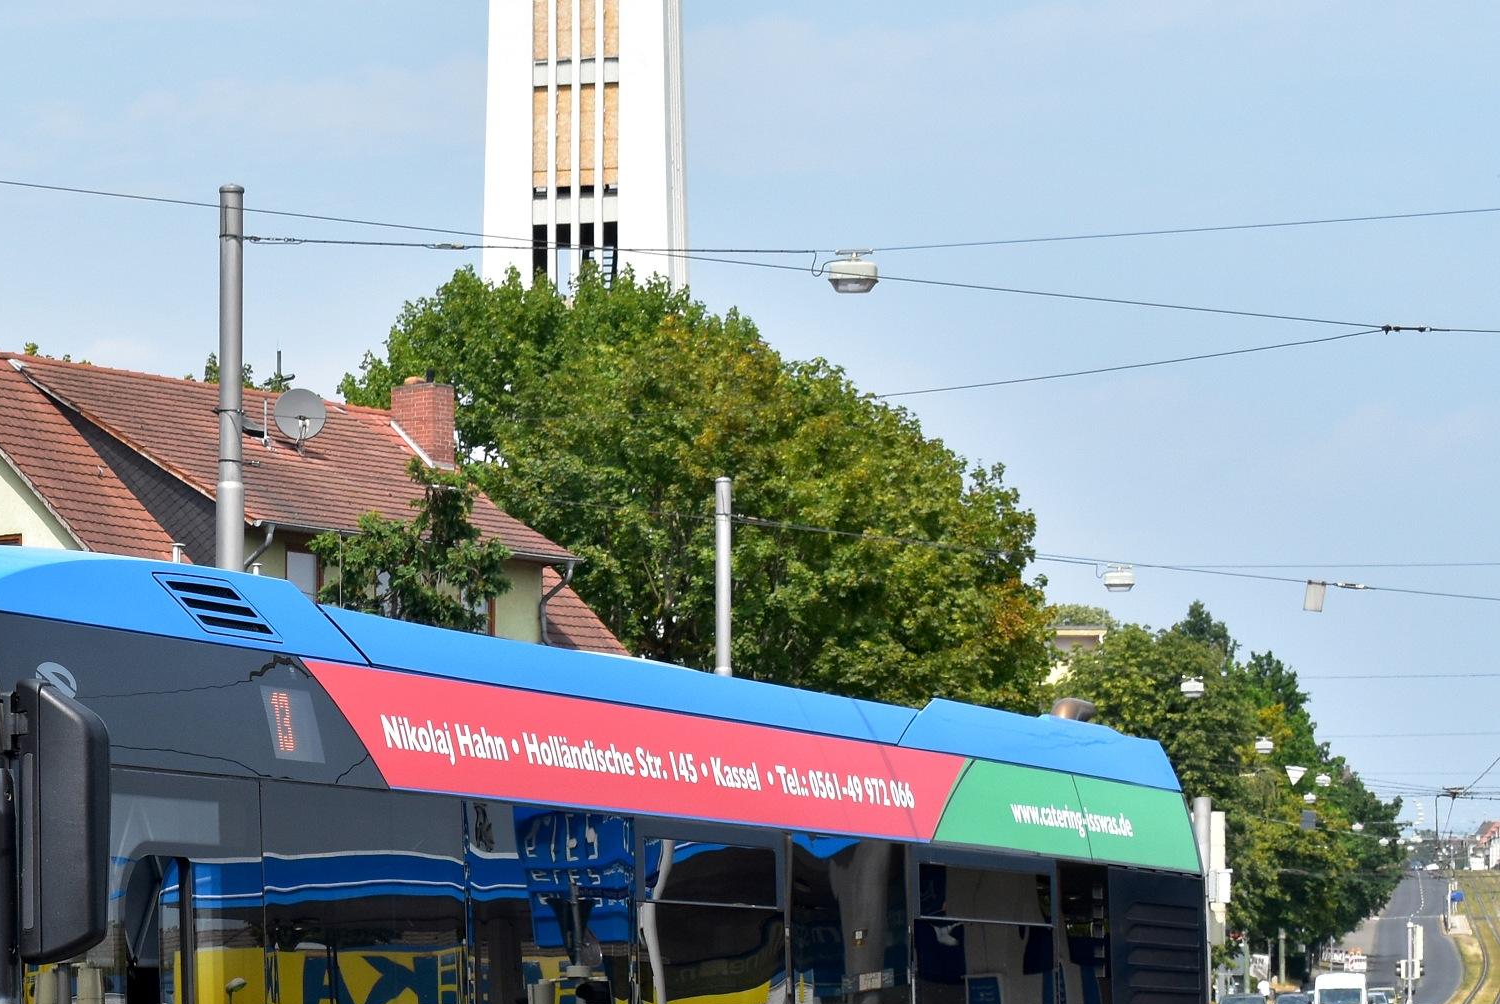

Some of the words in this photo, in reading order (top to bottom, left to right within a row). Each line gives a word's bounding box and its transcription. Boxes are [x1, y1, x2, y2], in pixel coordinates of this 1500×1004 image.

[271, 692, 294, 751] 13
[380, 713, 456, 766] Nikolaj
[454, 723, 509, 761] Hahn
[522, 731, 636, 777] Holländische
[635, 746, 667, 780] Str.
[669, 751, 698, 784] 145
[710, 756, 761, 791] Kassel
[775, 765, 809, 796] Tel.:
[1010, 803, 1134, 838] www.catering-isswas.de
